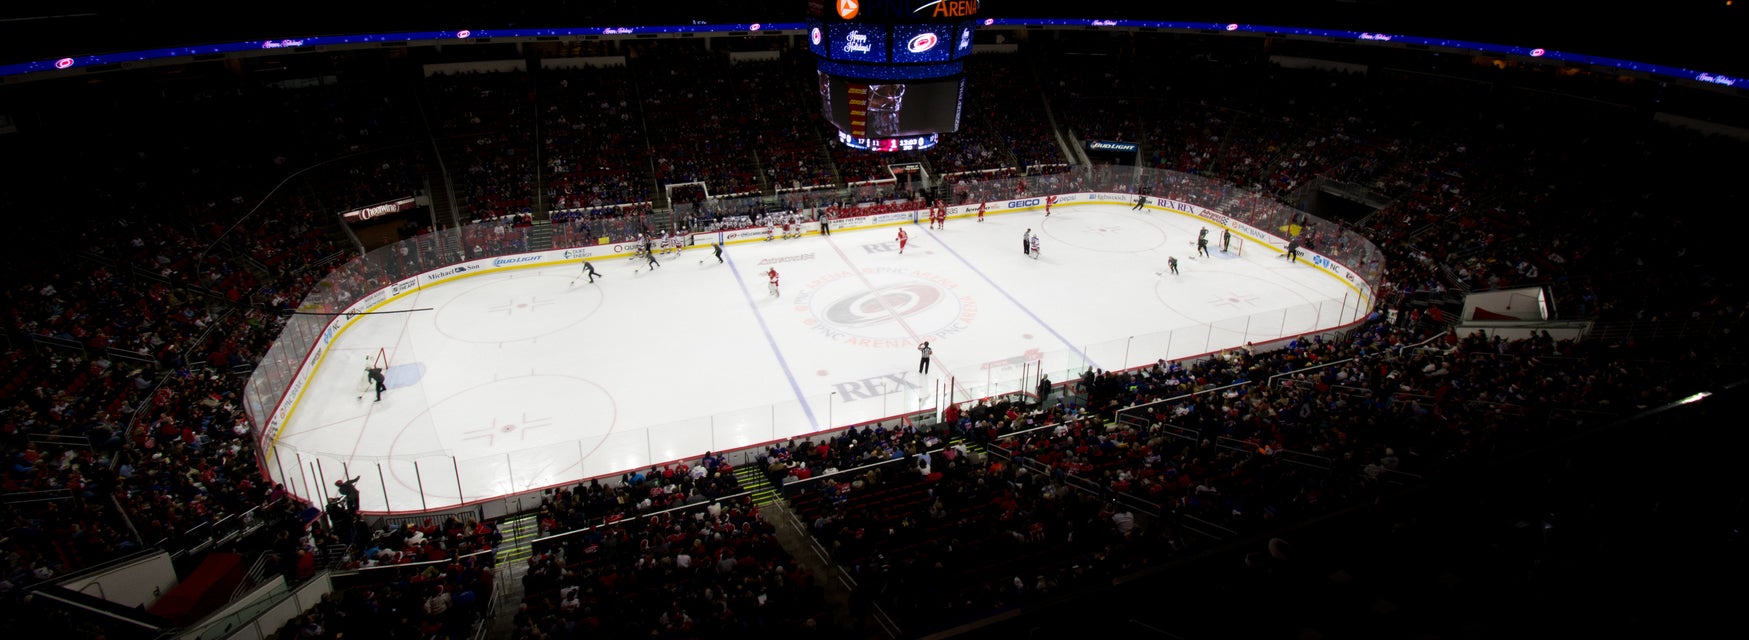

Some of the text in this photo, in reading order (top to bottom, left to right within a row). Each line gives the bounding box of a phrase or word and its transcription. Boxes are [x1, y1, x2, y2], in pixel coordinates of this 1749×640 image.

[932, 0, 978, 17] ARENA
[846, 30, 867, 43] Happy
[844, 42, 871, 54] Holidays!
[891, 139, 897, 148] 1
[1008, 198, 1040, 208] GEICO
[1095, 193, 1127, 201] Highwoods
[361, 203, 397, 220] Cheerwine
[1157, 199, 1175, 209] REX
[1177, 203, 1194, 214] REX
[428, 264, 480, 281] Michael Son
[1330, 262, 1340, 274] NC
[332, 319, 341, 331] NC
[846, 335, 912, 349] ARENA
[832, 370, 923, 403] REX
